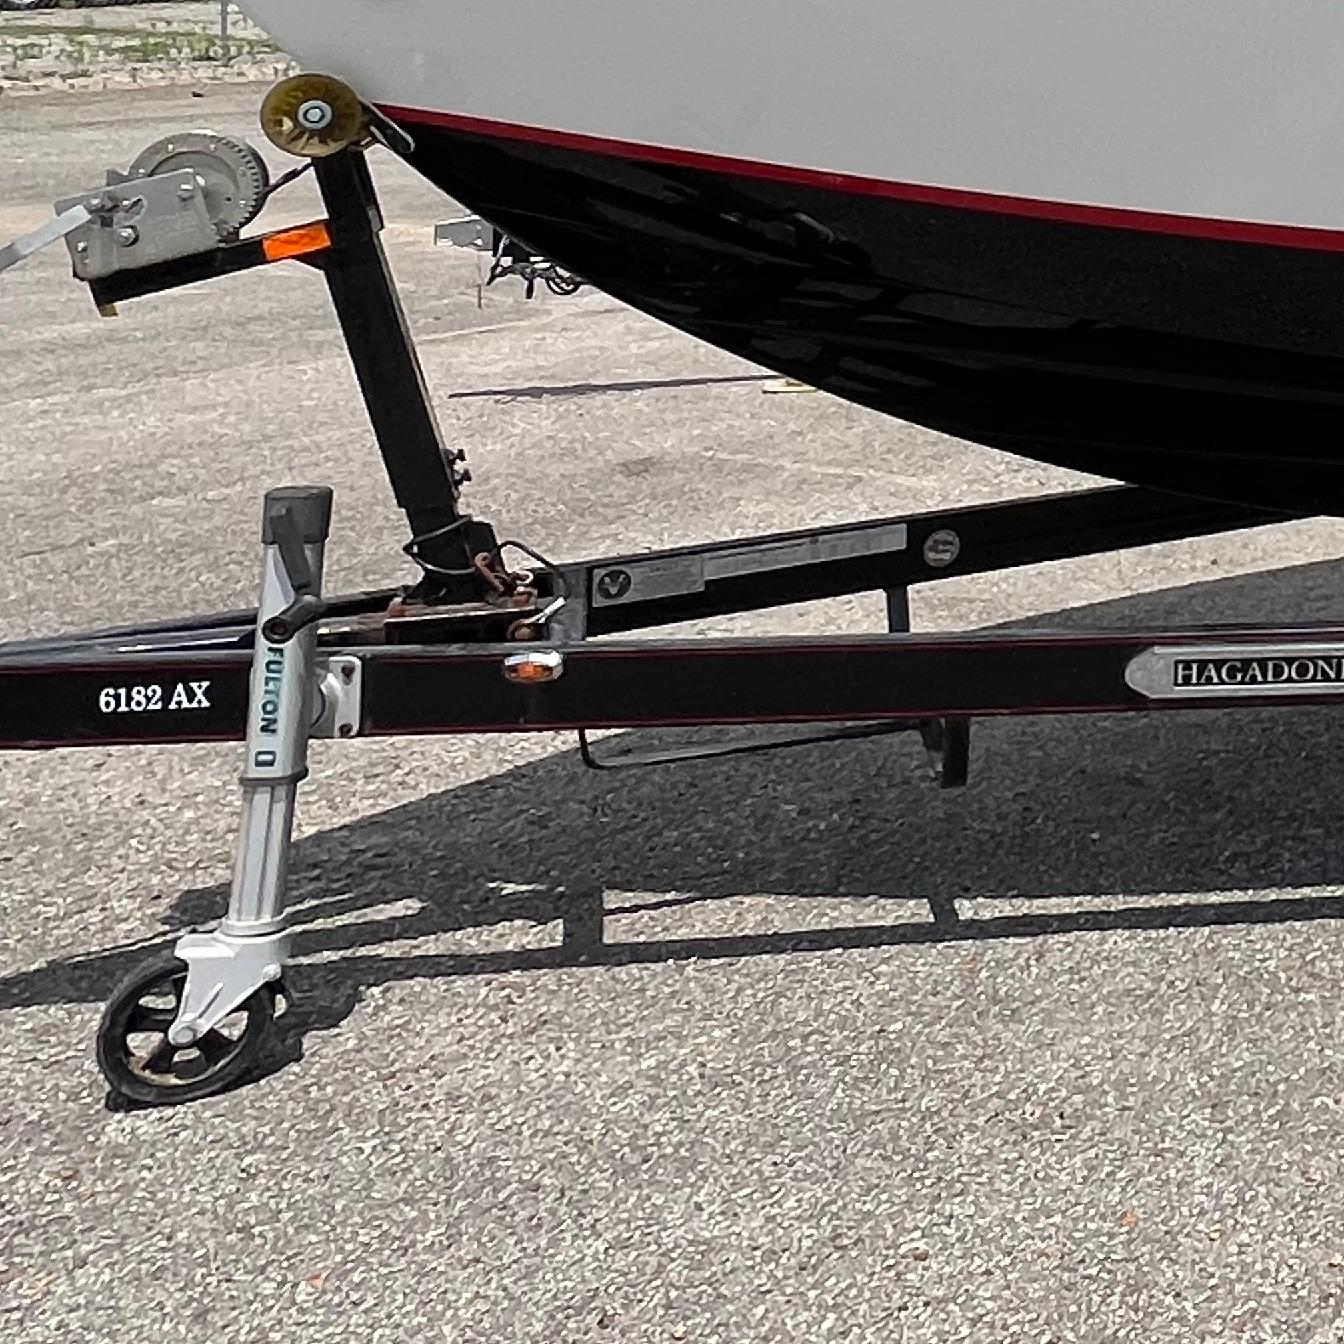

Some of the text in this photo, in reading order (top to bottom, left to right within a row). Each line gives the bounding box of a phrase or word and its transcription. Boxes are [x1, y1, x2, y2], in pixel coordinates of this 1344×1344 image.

[98, 680, 212, 713] 6182 AX
[259, 646, 284, 734] FULTON
